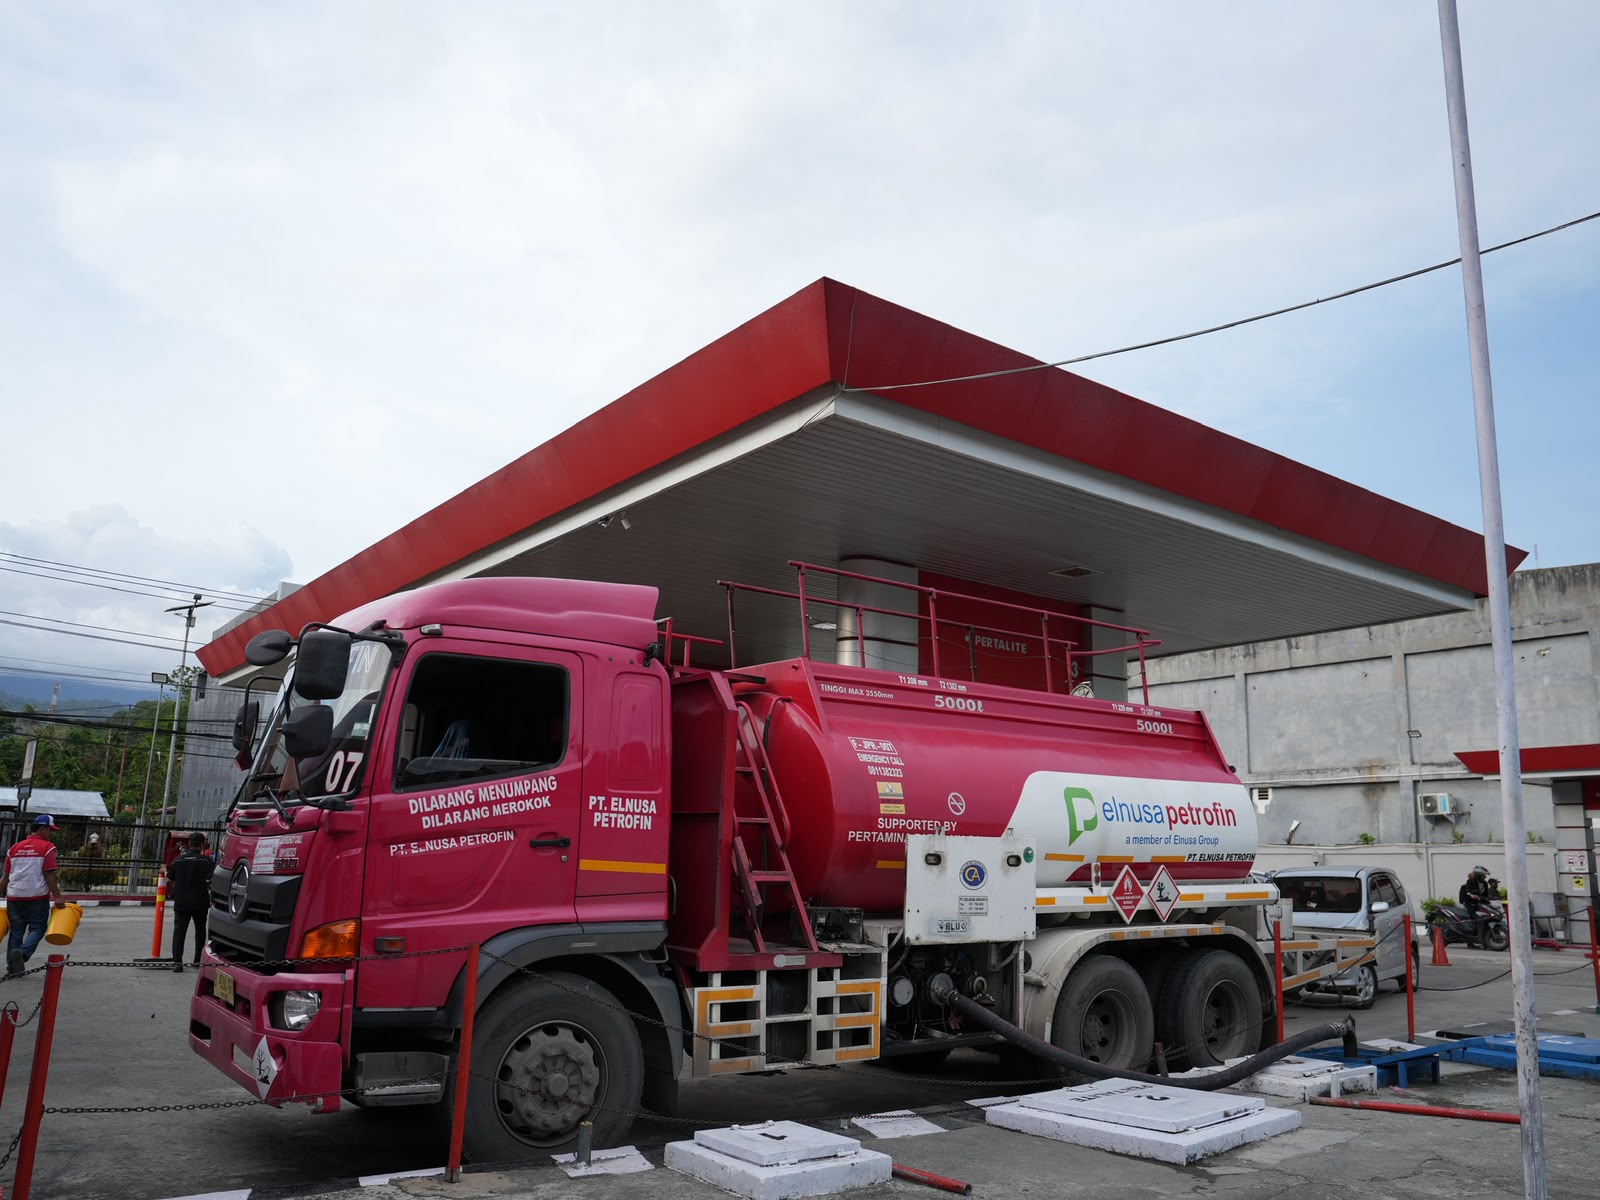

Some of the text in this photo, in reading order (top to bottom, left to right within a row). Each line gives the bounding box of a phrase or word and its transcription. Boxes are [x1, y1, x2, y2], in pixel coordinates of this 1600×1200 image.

[975, 635, 1027, 654] PERTALITE
[1071, 660, 1079, 678] 3
[820, 683, 894, 699] TINGGI MAX 3550mm
[857, 753, 904, 766] EMERGENCY CALL
[325, 750, 364, 793] 07
[408, 775, 558, 815] DILARANG MENUMPANG
[421, 795, 551, 829] DILARANG MEROKOK
[588, 795, 657, 814] PT. ELNUSA
[593, 812, 652, 830] PETROFIN
[877, 817, 958, 832] SUPPORTED BY
[389, 830, 514, 857] PT. ELNUSA PETROFIN
[1125, 834, 1219, 847] a member of Elnusa Group
[1186, 853, 1256, 862] PT. ELNUSA PETROFIN
